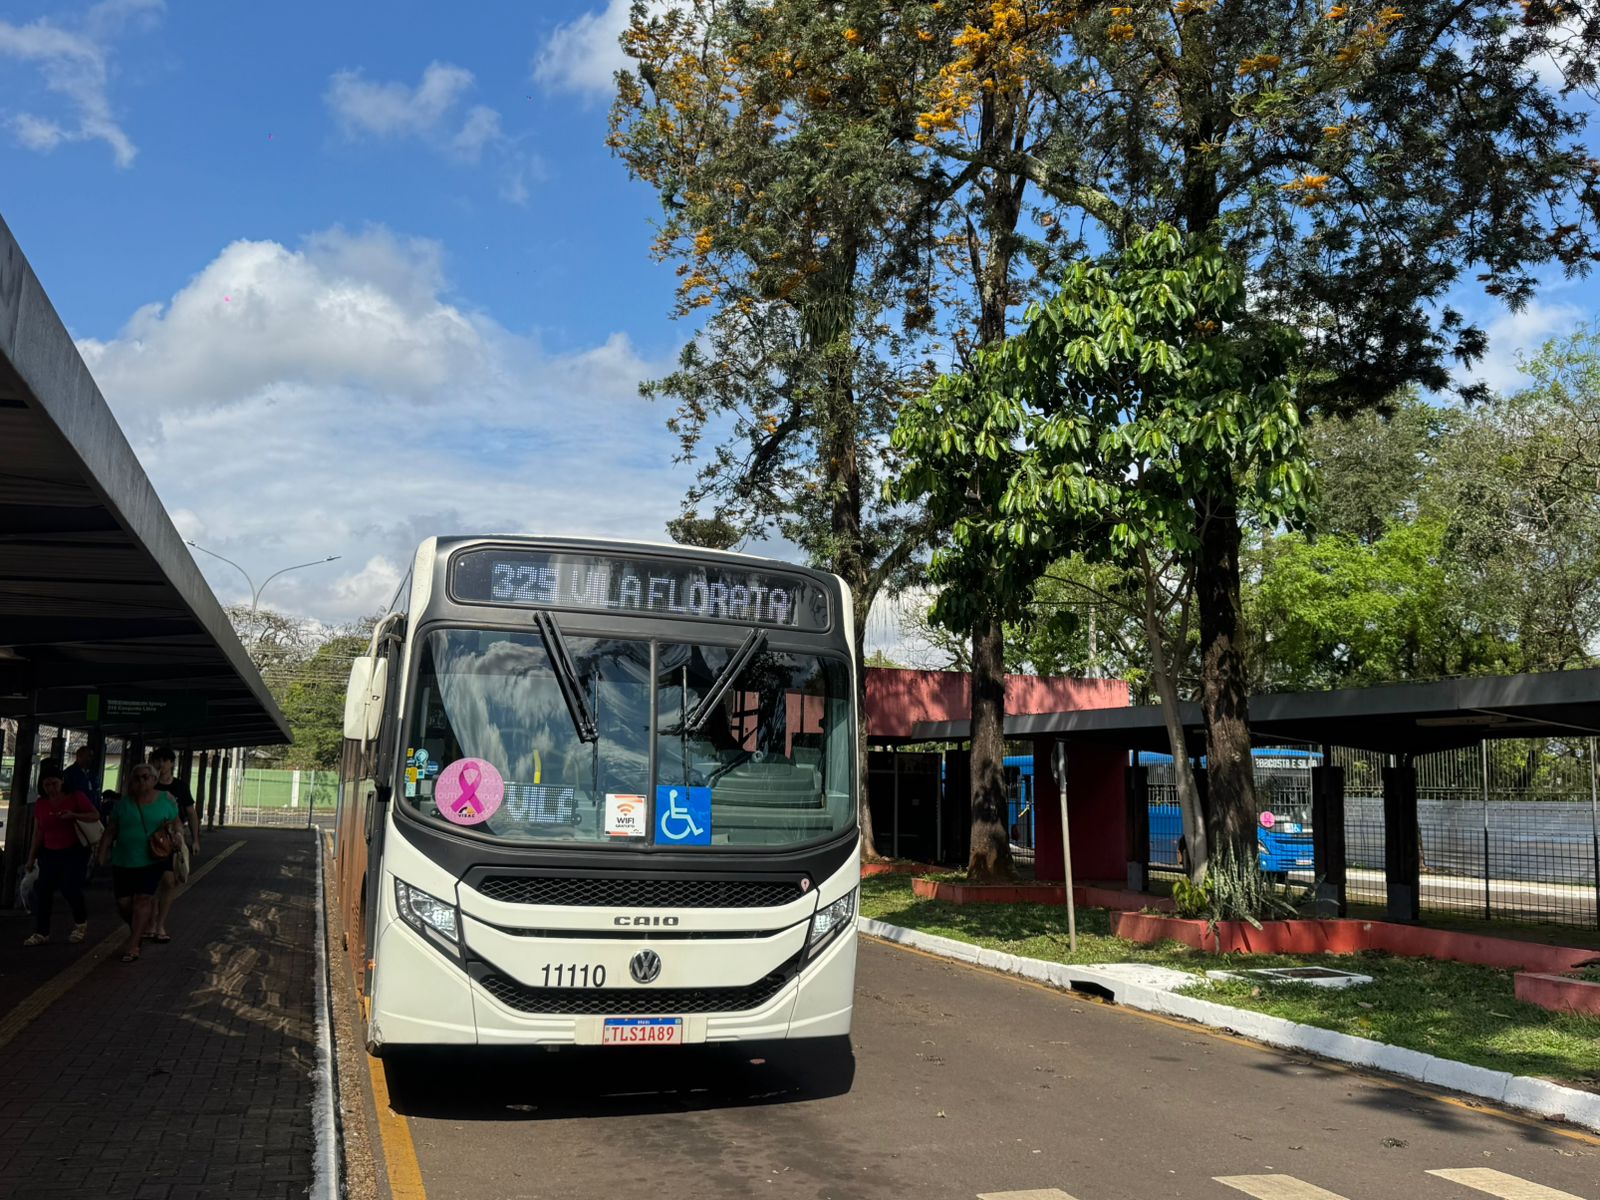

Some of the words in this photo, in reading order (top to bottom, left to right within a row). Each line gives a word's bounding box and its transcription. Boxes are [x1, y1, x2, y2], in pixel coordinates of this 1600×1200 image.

[493, 563, 559, 601] 325
[571, 570, 641, 608] VILA
[648, 578, 788, 619] FLORATA
[614, 916, 679, 926] CAIO
[541, 964, 606, 987] 11110
[611, 1026, 674, 1042] TLS1A89
